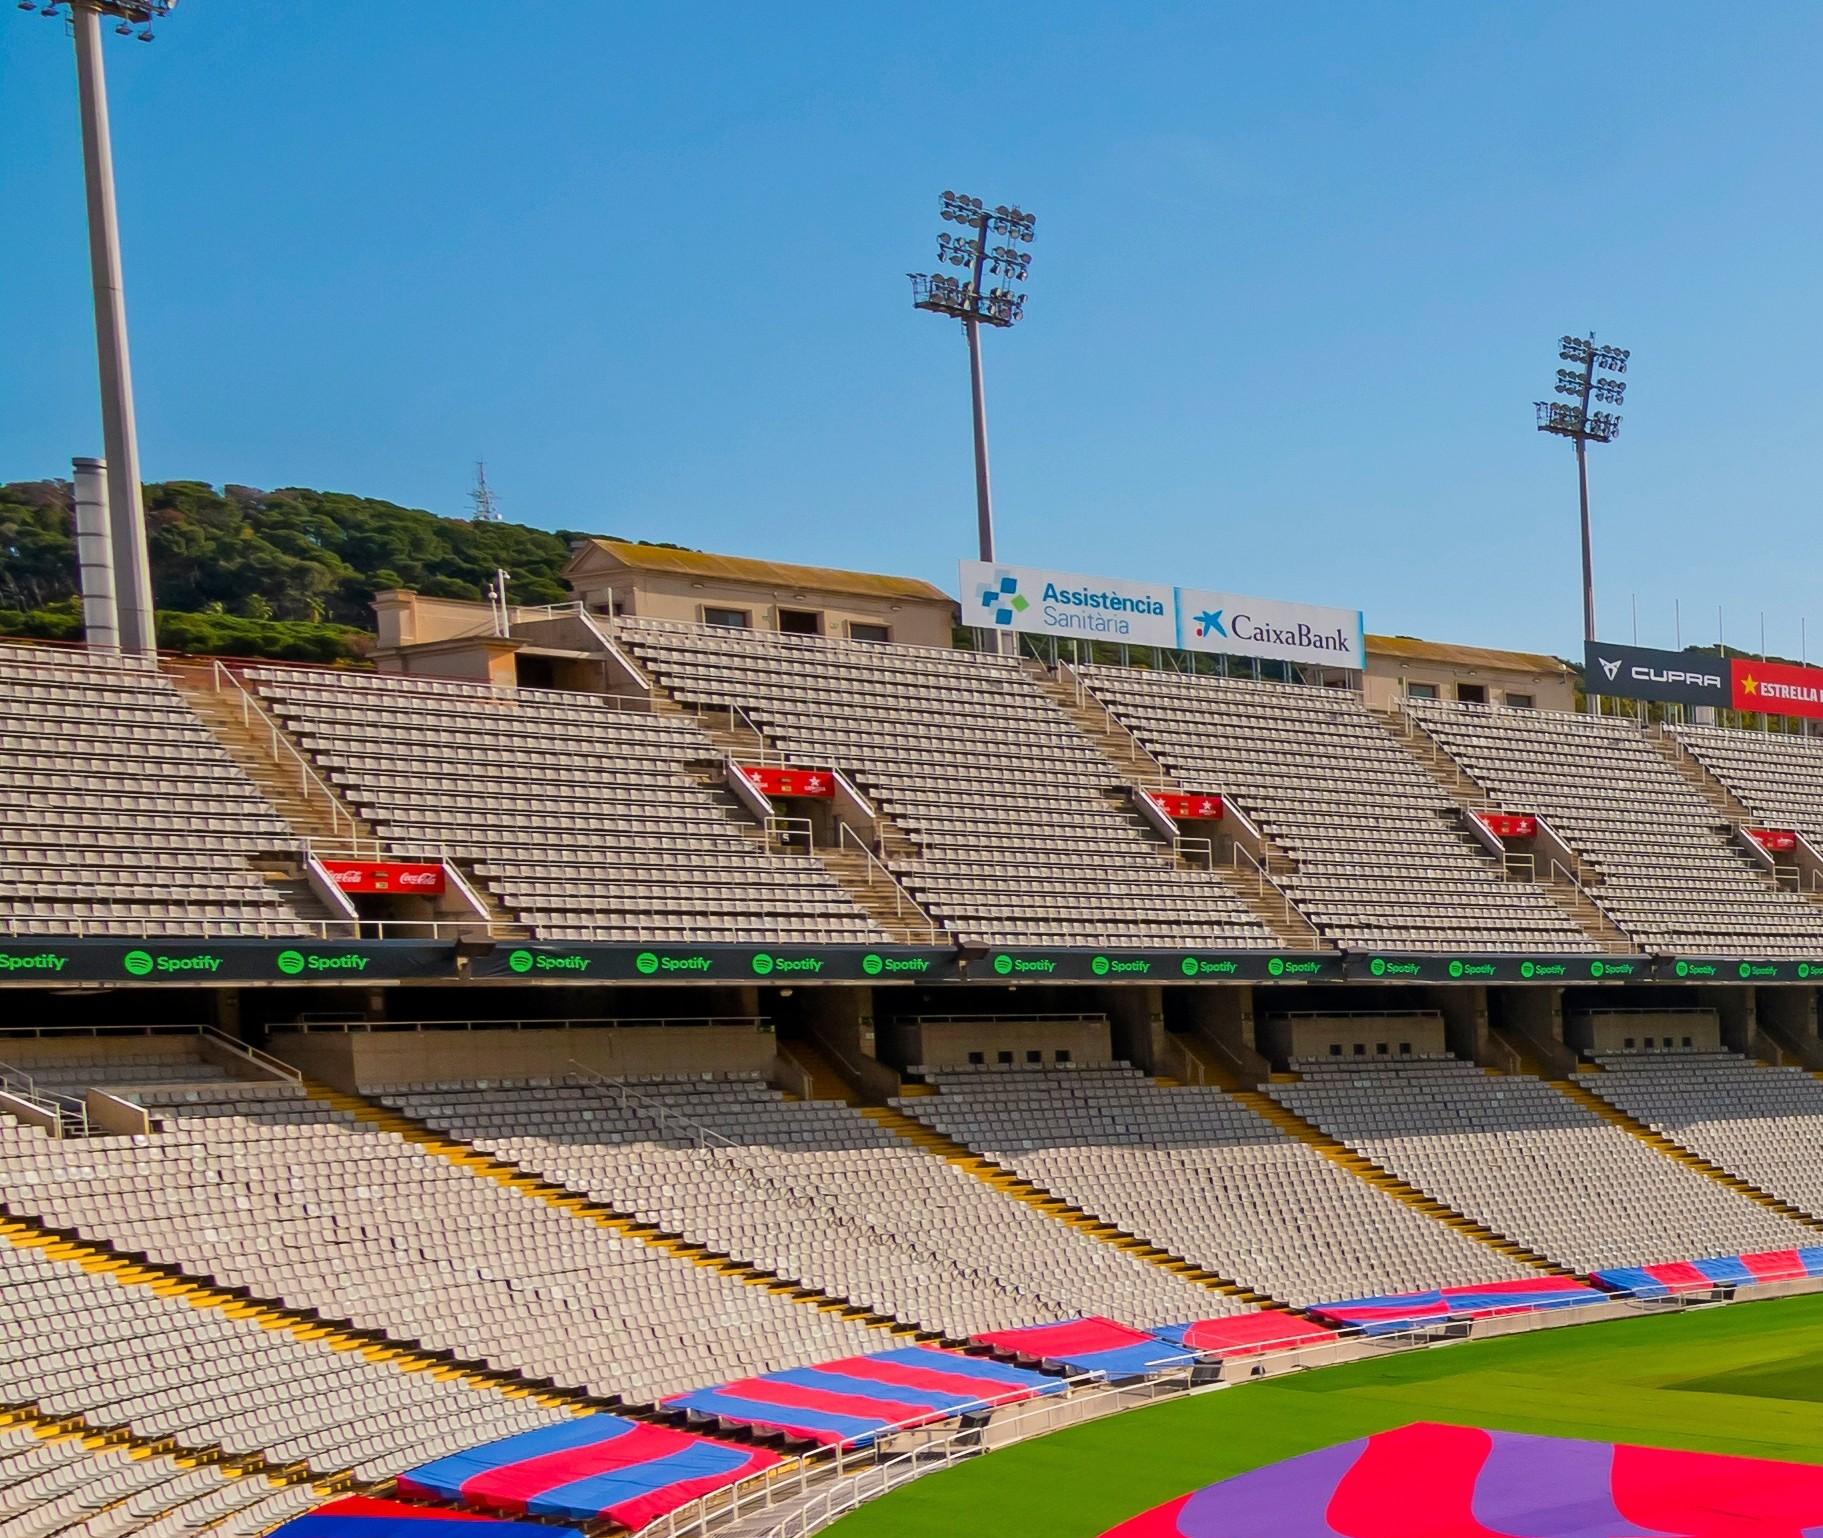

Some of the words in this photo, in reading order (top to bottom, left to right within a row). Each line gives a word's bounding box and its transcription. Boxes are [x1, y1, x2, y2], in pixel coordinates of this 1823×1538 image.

[1042, 582, 1164, 616] Assistència
[1043, 605, 1130, 635] Sanitària
[1231, 614, 1351, 653] CaixaBank
[1631, 666, 1721, 688] CUPRA
[1760, 682, 1818, 703] ESTRELLA
[399, 871, 437, 885] Coca-Cola
[0, 953, 66, 971] Spotify
[156, 954, 221, 973] Spotify
[306, 953, 369, 972] Spotify
[535, 953, 589, 971] Spotify
[661, 955, 711, 972] Spotify
[775, 957, 823, 972] Spotify
[885, 958, 929, 973] Spotify
[1014, 959, 1056, 973] Spotify
[1111, 960, 1151, 973] Spotify
[1199, 960, 1238, 974] Spotify
[1286, 961, 1321, 974] Spotify
[1386, 962, 1420, 975] Spotify
